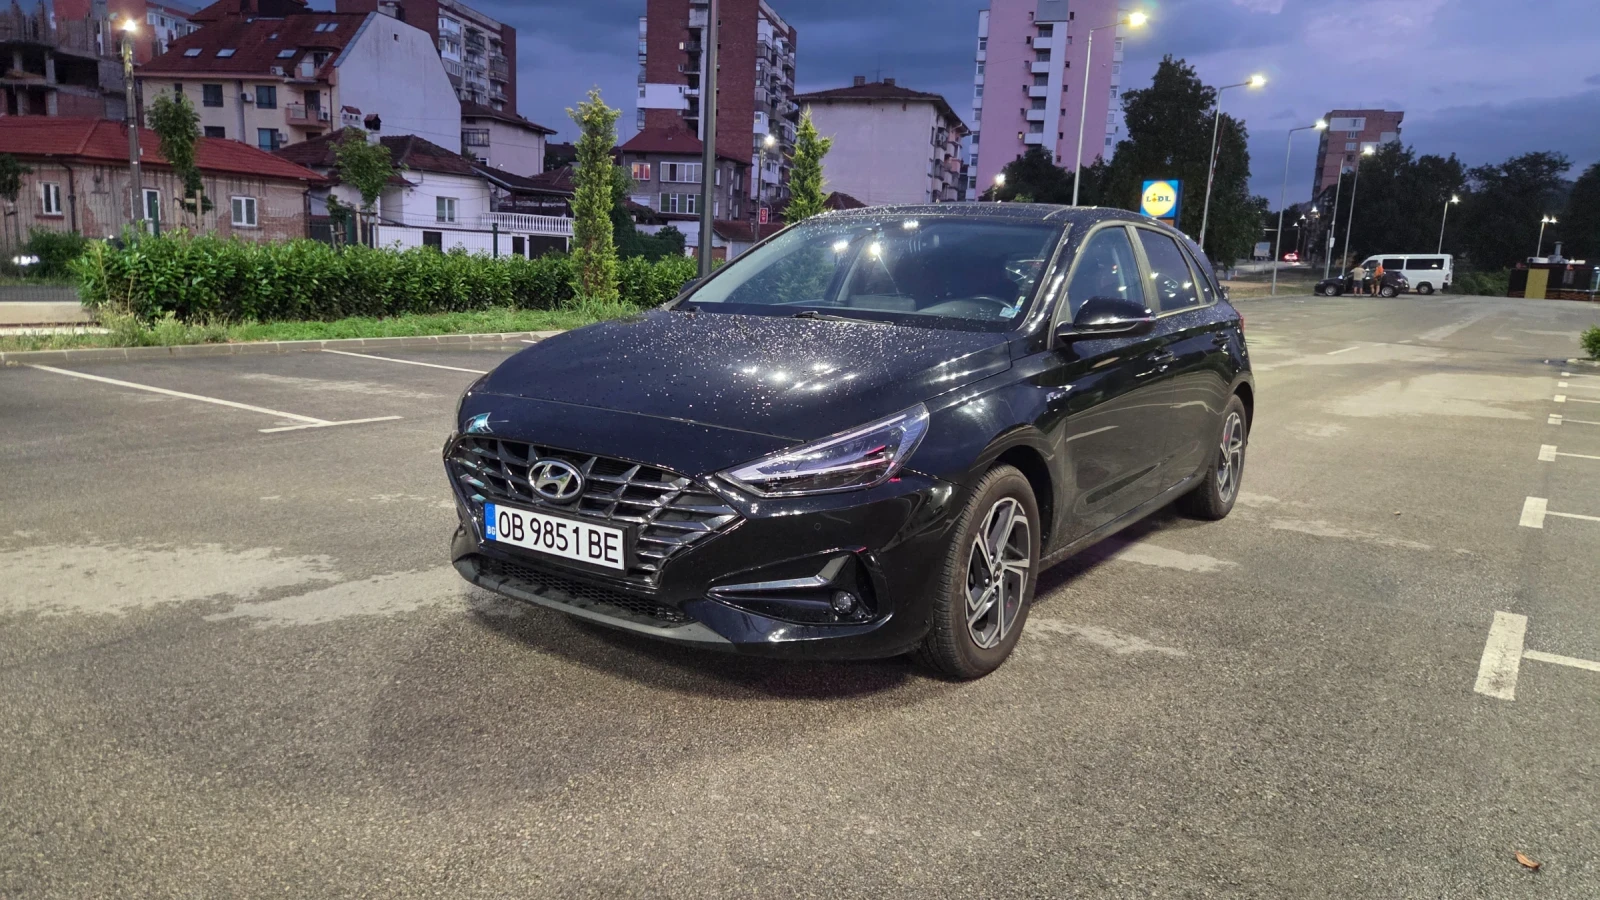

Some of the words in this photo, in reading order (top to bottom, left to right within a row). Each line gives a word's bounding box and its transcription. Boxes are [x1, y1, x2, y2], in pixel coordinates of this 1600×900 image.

[487, 525, 496, 536] BG
[499, 511, 525, 542] OB
[529, 517, 580, 555] 9851
[588, 528, 619, 564] BE
